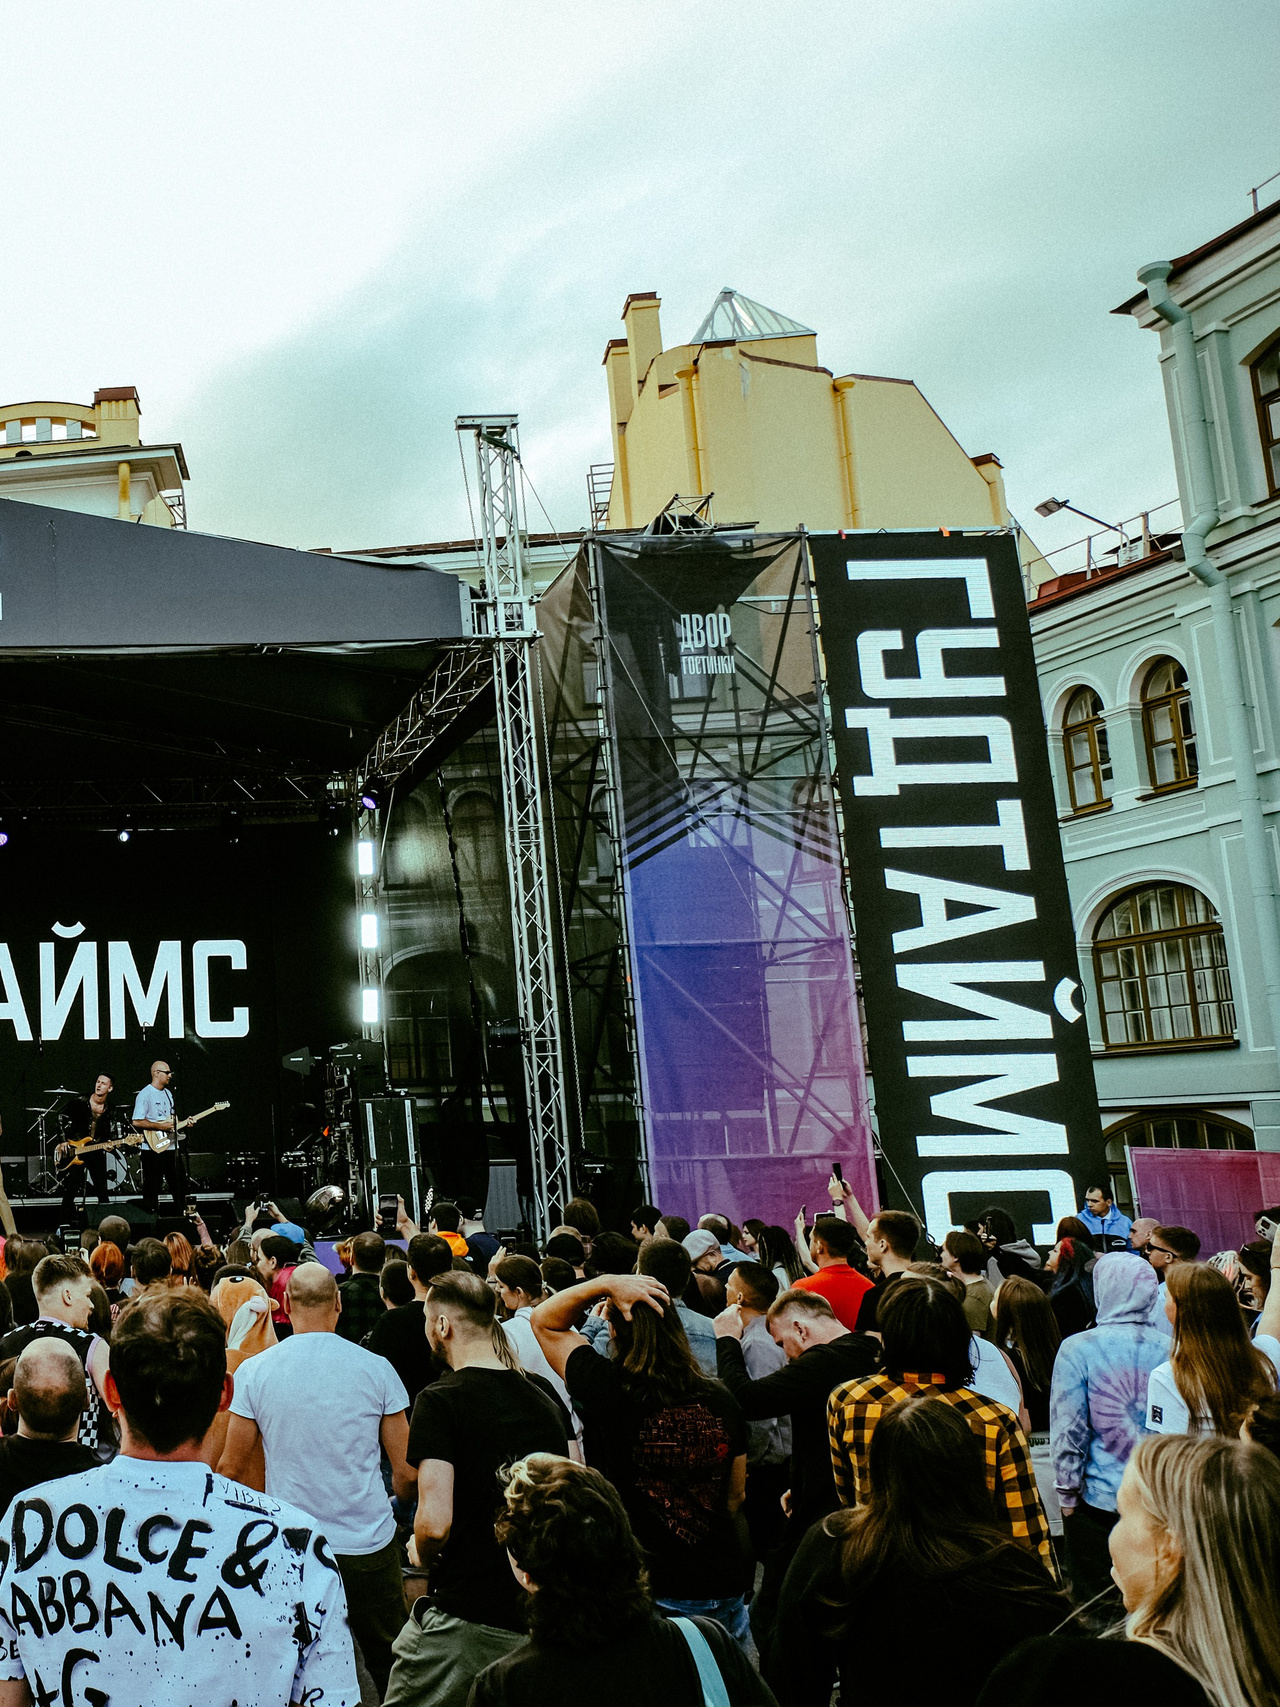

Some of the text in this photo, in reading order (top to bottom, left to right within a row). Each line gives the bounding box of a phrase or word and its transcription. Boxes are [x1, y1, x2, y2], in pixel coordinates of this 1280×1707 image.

[680, 613, 732, 653] ДВОР
[681, 655, 736, 675] ГОСТИНКИ
[845, 557, 1081, 1248] ГУДТАЙМС
[218, 1480, 282, 1512] VIBES
[12, 1497, 279, 1598] DOLCE &
